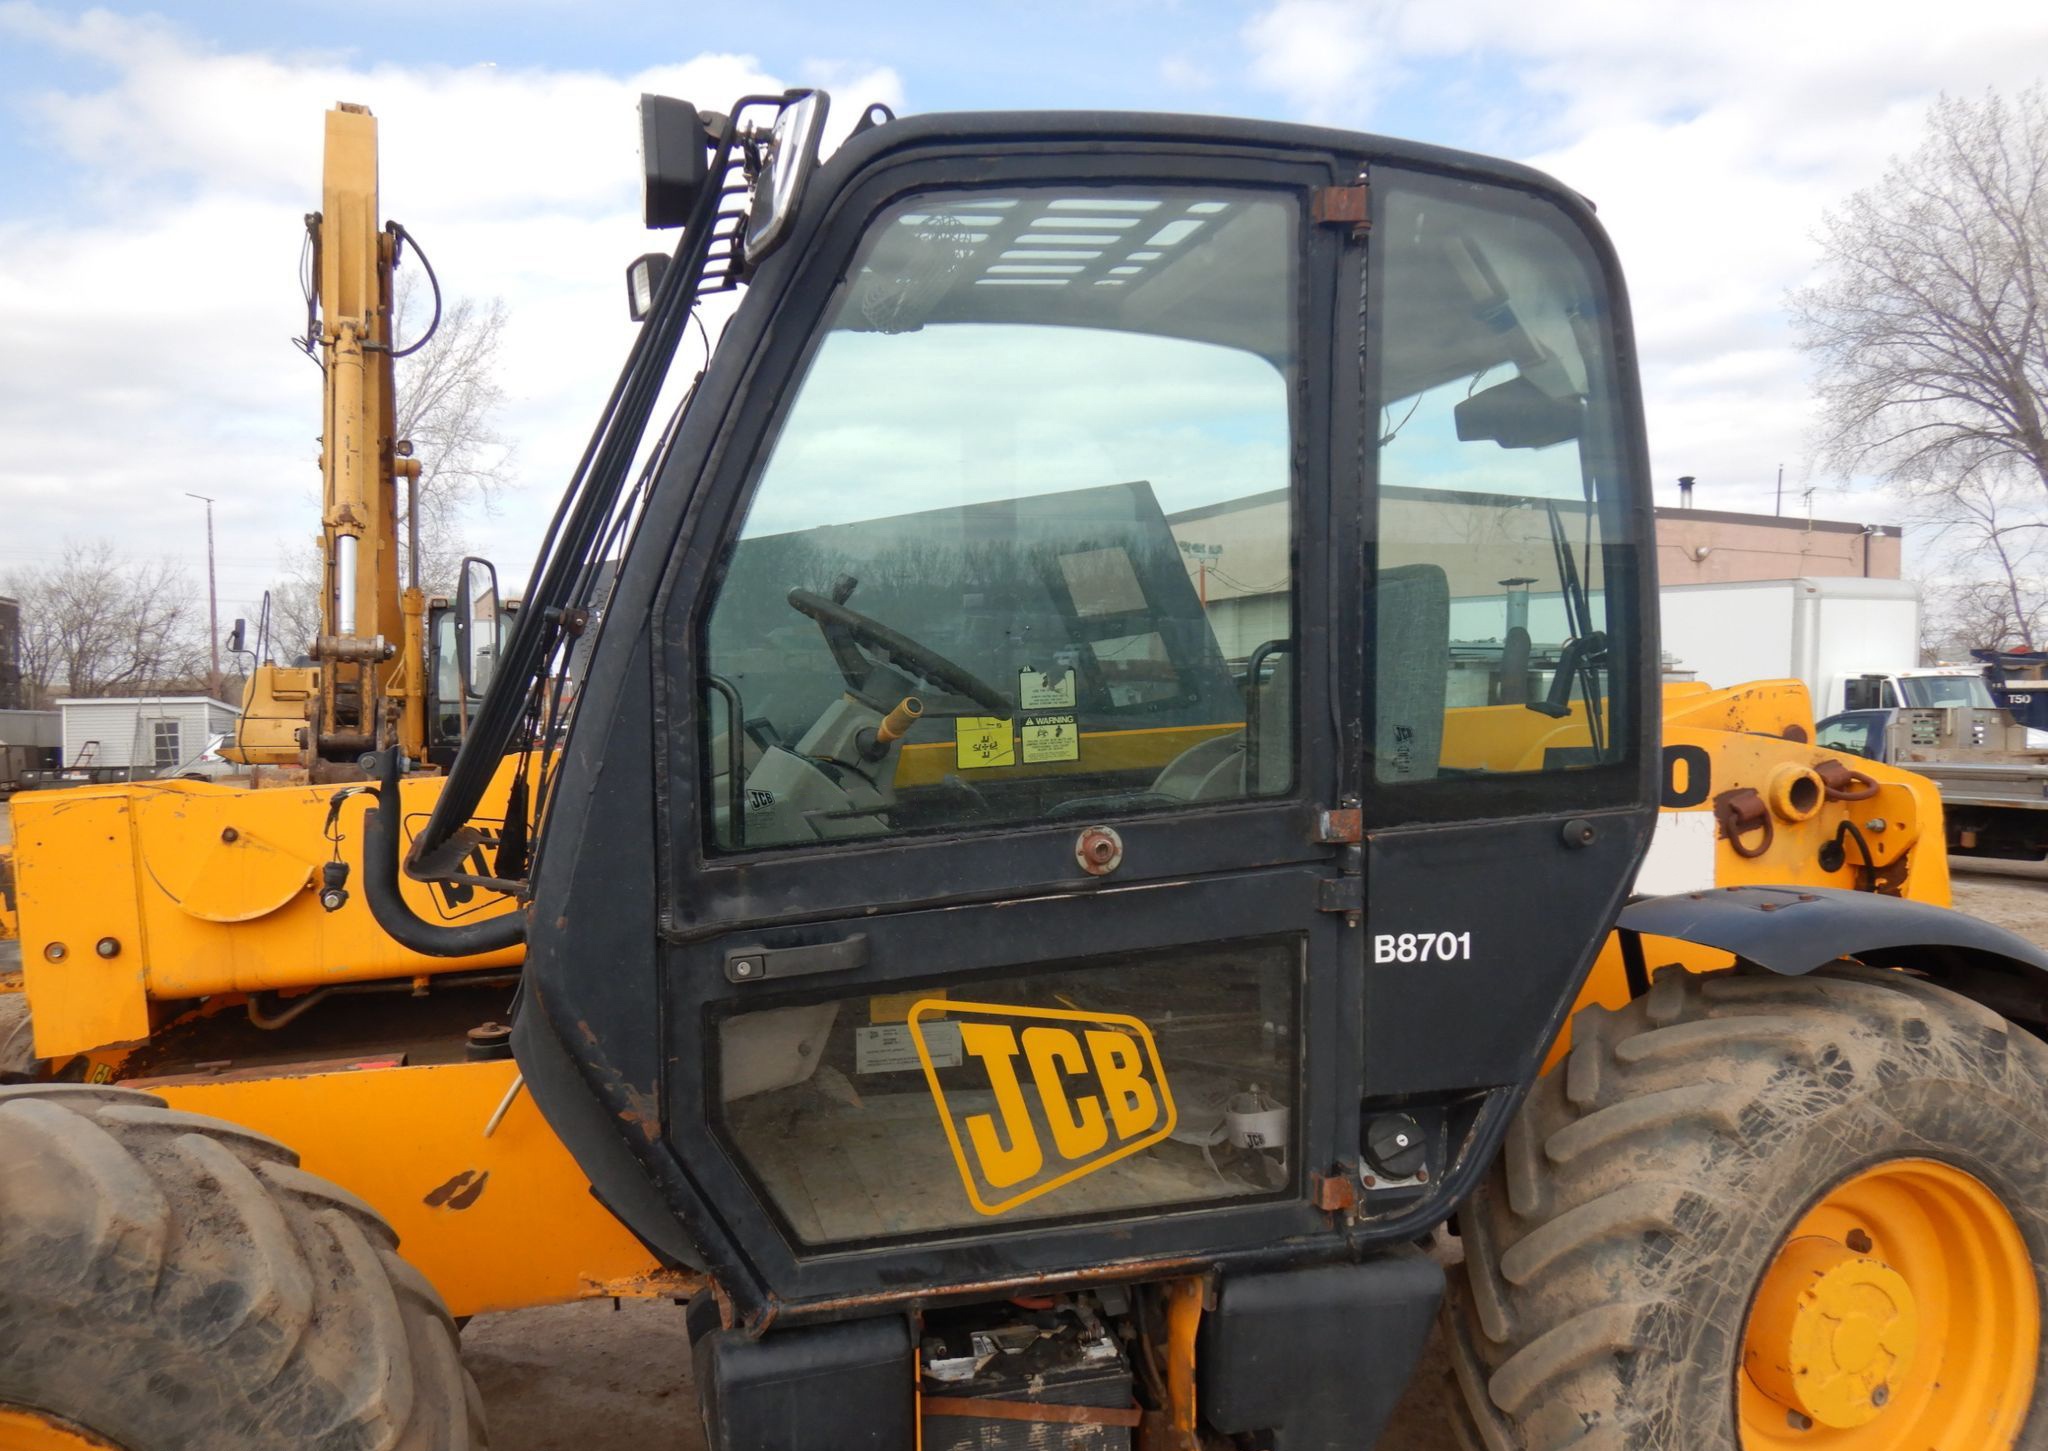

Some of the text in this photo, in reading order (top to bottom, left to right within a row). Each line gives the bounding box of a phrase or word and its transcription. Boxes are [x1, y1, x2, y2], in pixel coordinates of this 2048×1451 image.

[2008, 694, 2032, 704] T50
[1035, 715, 1074, 725] WARNING
[751, 791, 773, 808] JCB
[1374, 931, 1471, 963] B8701
[959, 1022, 1158, 1189] JCB
